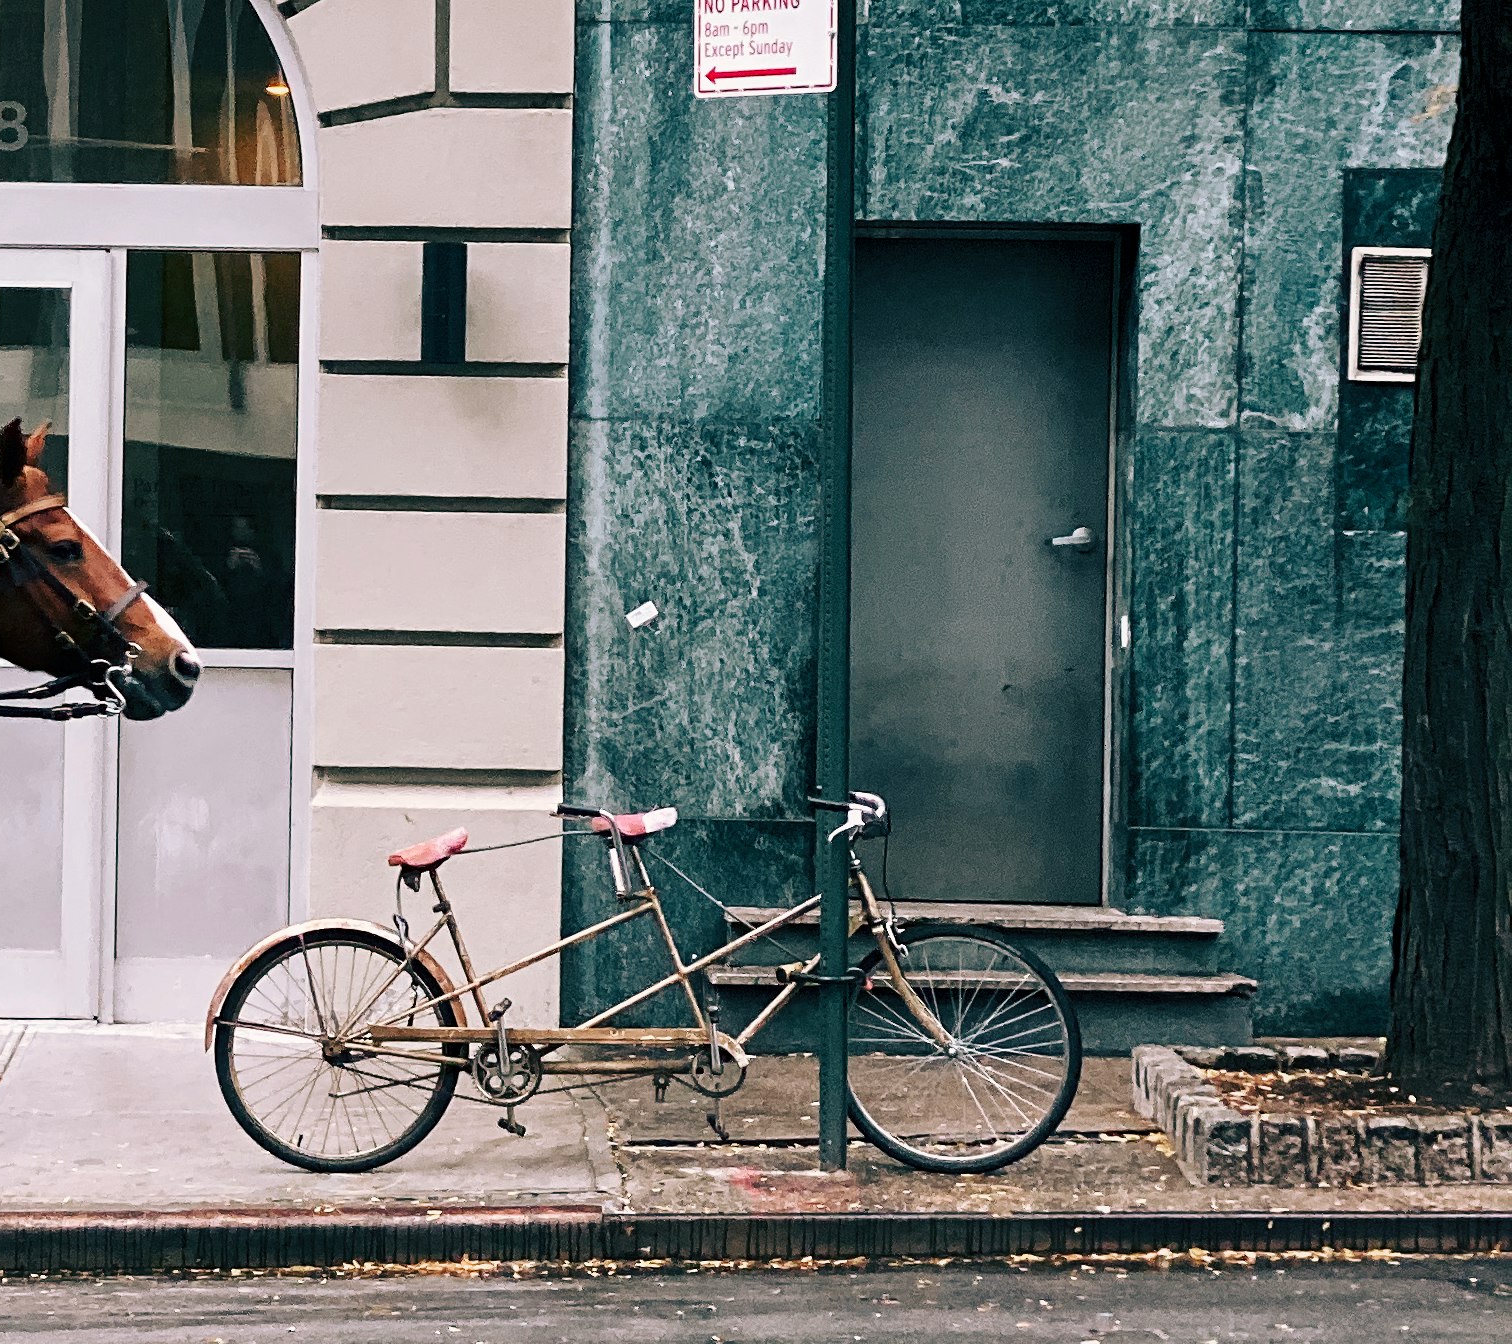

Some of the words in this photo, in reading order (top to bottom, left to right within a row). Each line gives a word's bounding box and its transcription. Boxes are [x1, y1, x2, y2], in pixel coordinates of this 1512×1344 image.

[704, 22, 730, 38] 8am
[742, 20, 769, 38] 6pm
[704, 41, 744, 59] Except
[749, 38, 794, 58] Sunday
